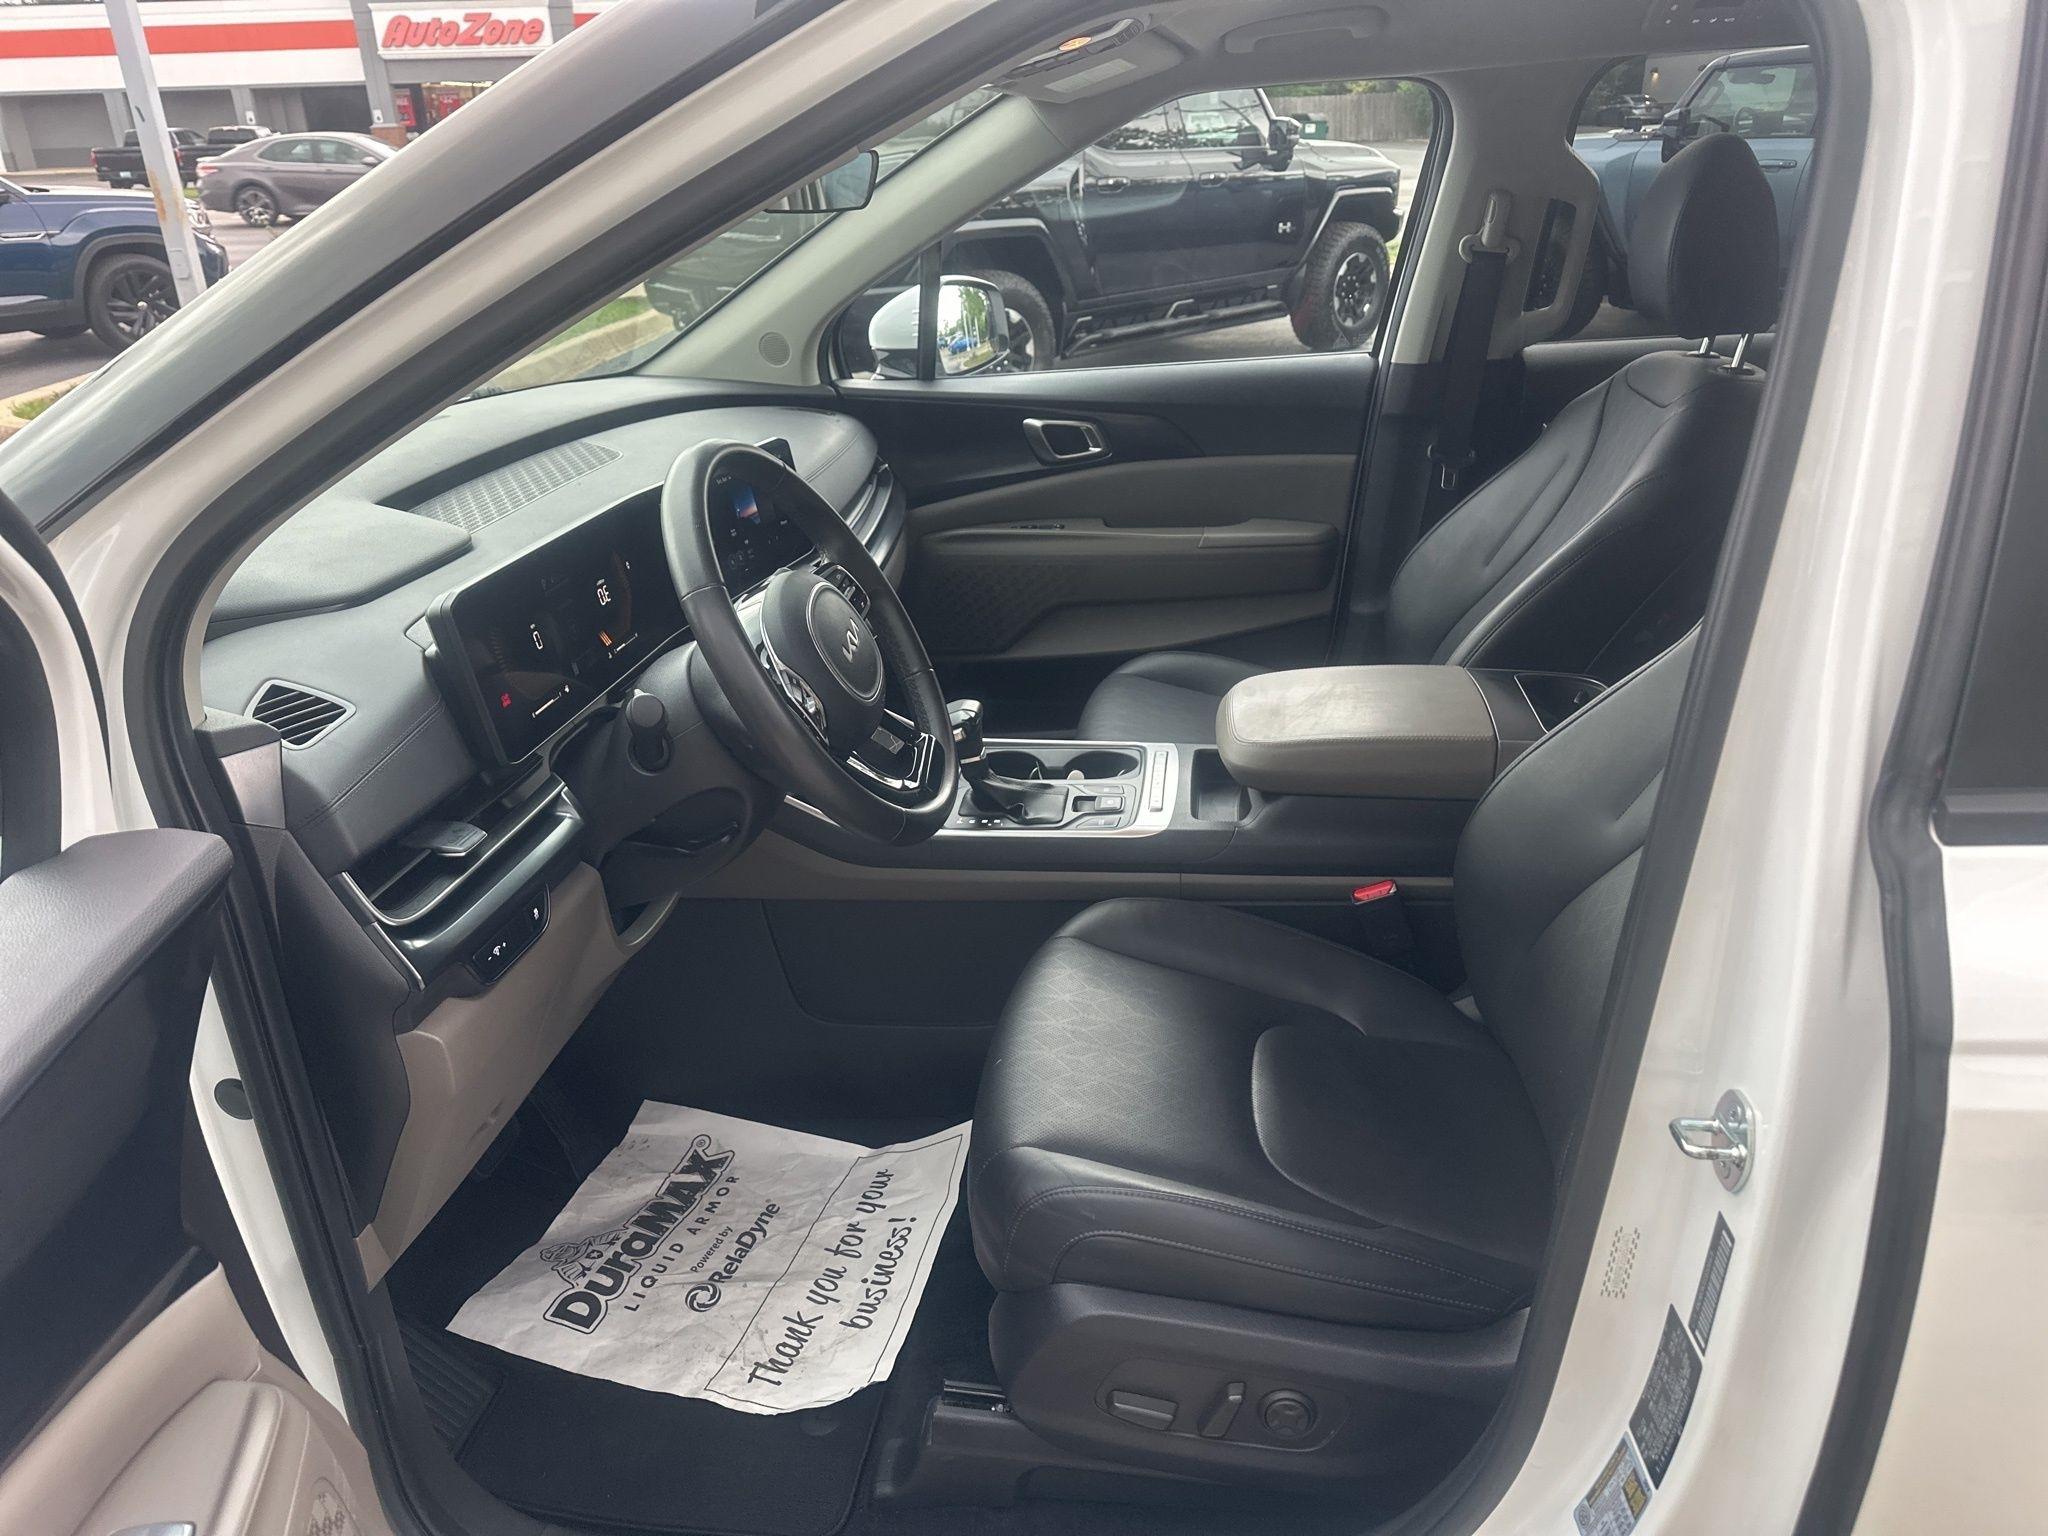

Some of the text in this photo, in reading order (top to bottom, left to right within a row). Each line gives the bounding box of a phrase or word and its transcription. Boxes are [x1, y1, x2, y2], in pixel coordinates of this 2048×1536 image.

[382, 12, 545, 48] AutoZone
[624, 1176, 740, 1311] LIQUID ARMOR
[690, 1225, 733, 1273] Powered by
[708, 1203, 781, 1284] RelaDyne
[748, 1168, 894, 1386] Thank you for your
[838, 1216, 917, 1330] business!
